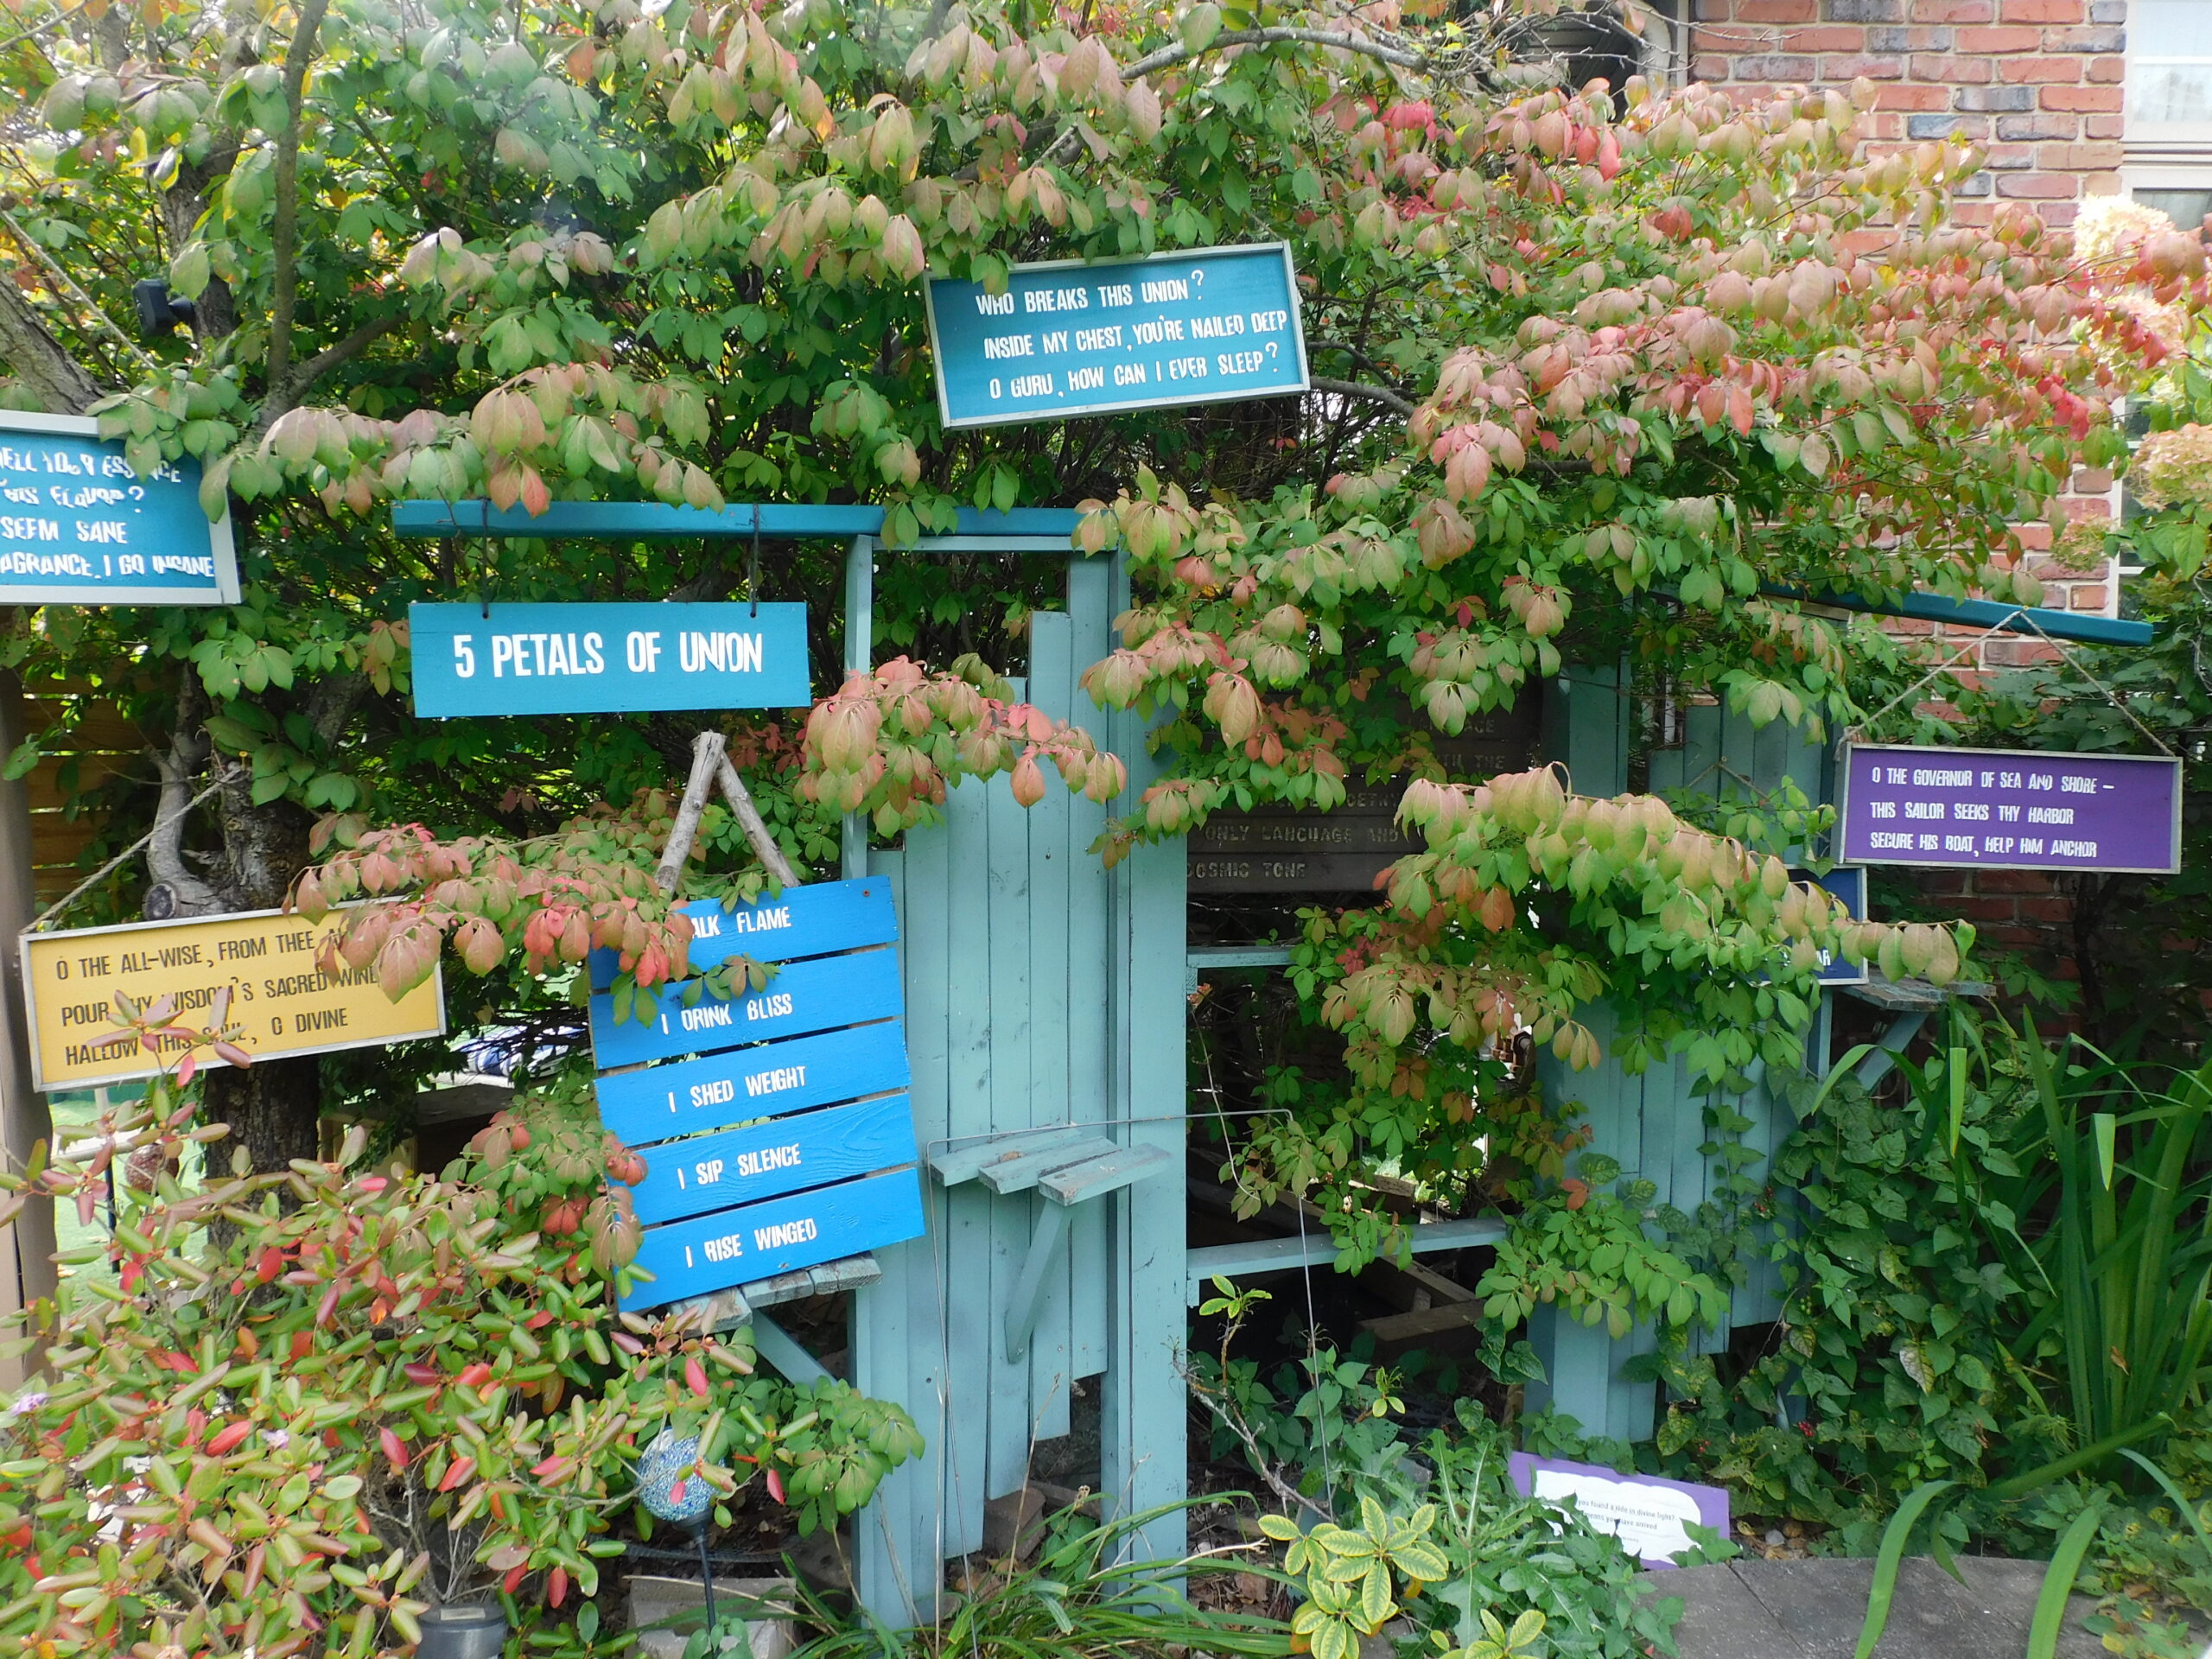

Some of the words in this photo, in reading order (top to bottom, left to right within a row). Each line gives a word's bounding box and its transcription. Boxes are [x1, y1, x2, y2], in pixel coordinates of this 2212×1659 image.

[976, 292, 1014, 315] WHO
[1026, 287, 1088, 313] BREAKS
[1098, 284, 1133, 307] THIS
[984, 336, 1034, 359] INSIDE
[1043, 332, 1068, 354] MY
[1132, 315, 1185, 344] YOU'RE
[1191, 315, 1245, 340] NAILED
[1251, 310, 1287, 334] DEEP
[989, 378, 1001, 399] O
[1068, 367, 1103, 391] HOW
[1113, 364, 1146, 386] CAN
[1156, 361, 1162, 382] I
[1169, 357, 1208, 381] EVER
[103, 455, 181, 483] ESSCE
[76, 521, 127, 543] SANE
[104, 555, 111, 576] I
[118, 554, 145, 575] GO
[152, 556, 214, 577] INSANE
[454, 634, 475, 677] 5
[492, 632, 604, 677] PETALS
[626, 631, 661, 673] OF
[679, 632, 763, 672] UNION
[1474, 755, 1506, 770] THE
[1872, 766, 1880, 783] O
[1886, 767, 1908, 785] THE
[1913, 769, 1973, 787] GOVERNOR
[1981, 772, 1995, 788] OF
[1999, 772, 2022, 790] SEA
[2028, 773, 2053, 791] AND
[2061, 776, 2098, 794] SHORE
[1870, 802, 1896, 819] THIS
[1904, 803, 1945, 820] SAILOR
[1954, 803, 1990, 821] SEEKS
[1998, 804, 2021, 823] THY
[2028, 806, 2075, 825] HARBOR
[1205, 825, 1249, 842] ONLY
[1262, 826, 1352, 843] LANGUAGE
[1871, 832, 1914, 850] SECURE
[1919, 834, 1938, 850] HIS
[1945, 835, 1980, 857] BOAT,
[1985, 836, 2014, 854] HELP
[2020, 837, 2044, 855] HIM
[2050, 839, 2097, 858] ANCHOR
[1262, 862, 1306, 879] TONE
[691, 915, 721, 939] ALK
[736, 906, 791, 933] FLAME
[56, 959, 69, 980] O
[79, 955, 111, 977] THE
[219, 937, 266, 961] FROM
[275, 931, 315, 955] THEE
[62, 1002, 109, 1027] POUR
[264, 972, 328, 999] SACRED
[661, 1013, 670, 1035] I
[681, 1002, 733, 1032] DRINK
[747, 993, 793, 1021] BLISS
[66, 1040, 138, 1066] HALLOW
[156, 1033, 192, 1054] THIS
[296, 1007, 348, 1033] DIVINE
[668, 1091, 677, 1113] I
[690, 1079, 734, 1108] SHED
[744, 1065, 807, 1097] WEIGHT
[677, 1168, 686, 1190] I
[695, 1160, 723, 1185] SIP
[736, 1143, 802, 1178] SILENCE
[685, 1245, 694, 1268] I
[704, 1234, 743, 1262] RISE
[753, 1217, 817, 1252] WINGED
